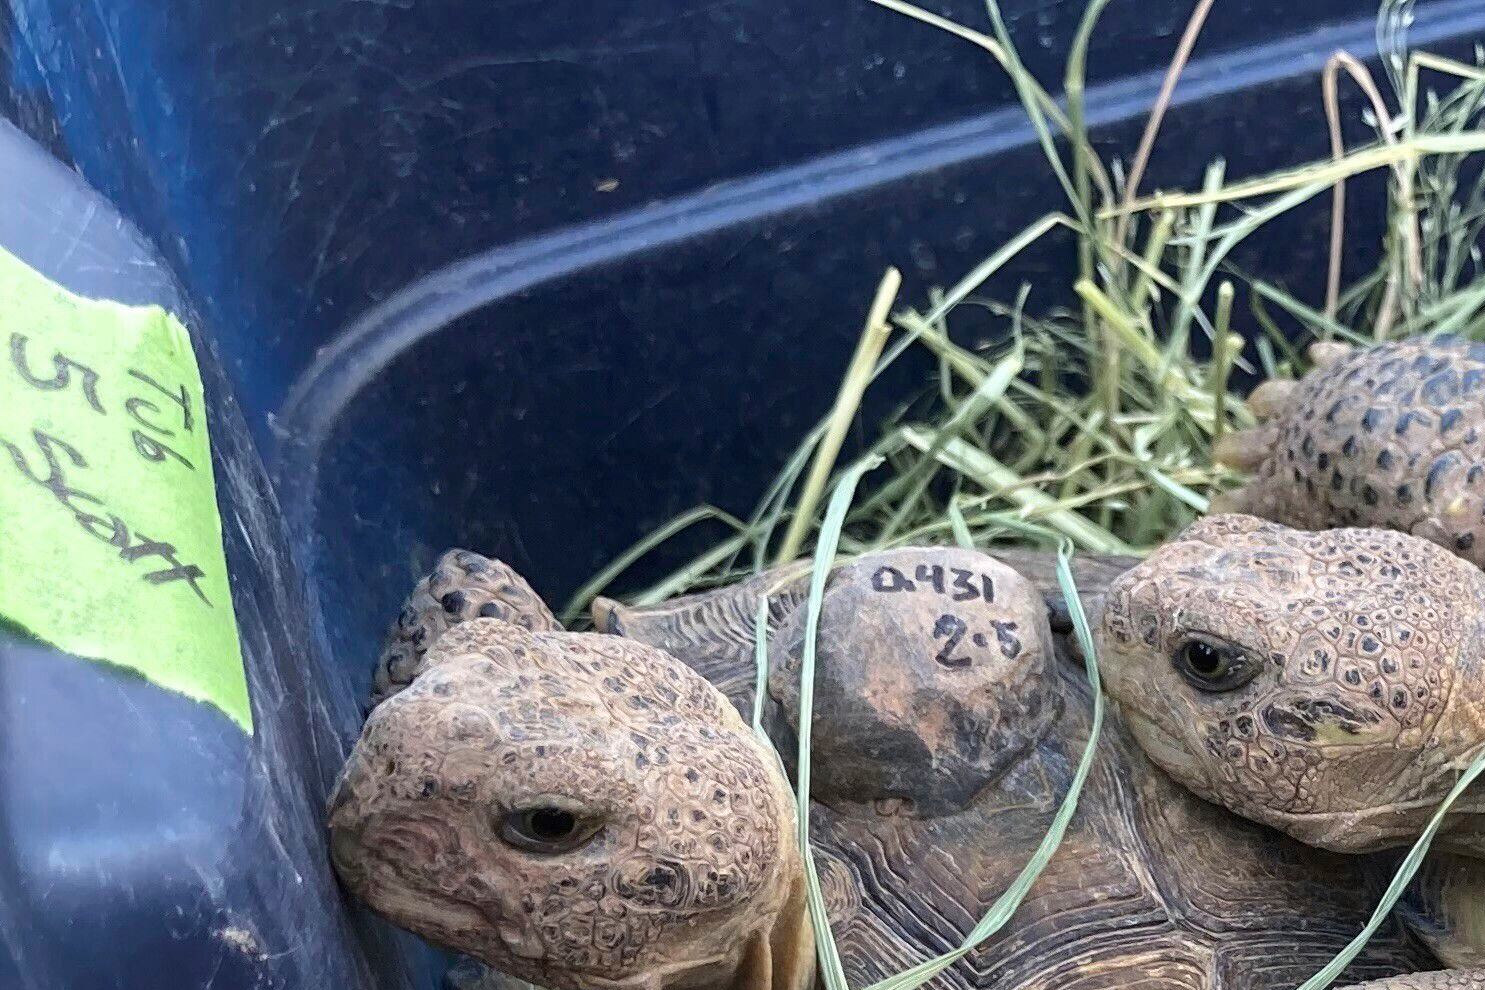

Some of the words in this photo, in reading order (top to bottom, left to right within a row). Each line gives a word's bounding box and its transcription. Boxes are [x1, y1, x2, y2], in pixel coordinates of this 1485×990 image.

[9, 332, 107, 416] 5
[125, 369, 195, 470] Tub
[933, 614, 1022, 668] 2.5
